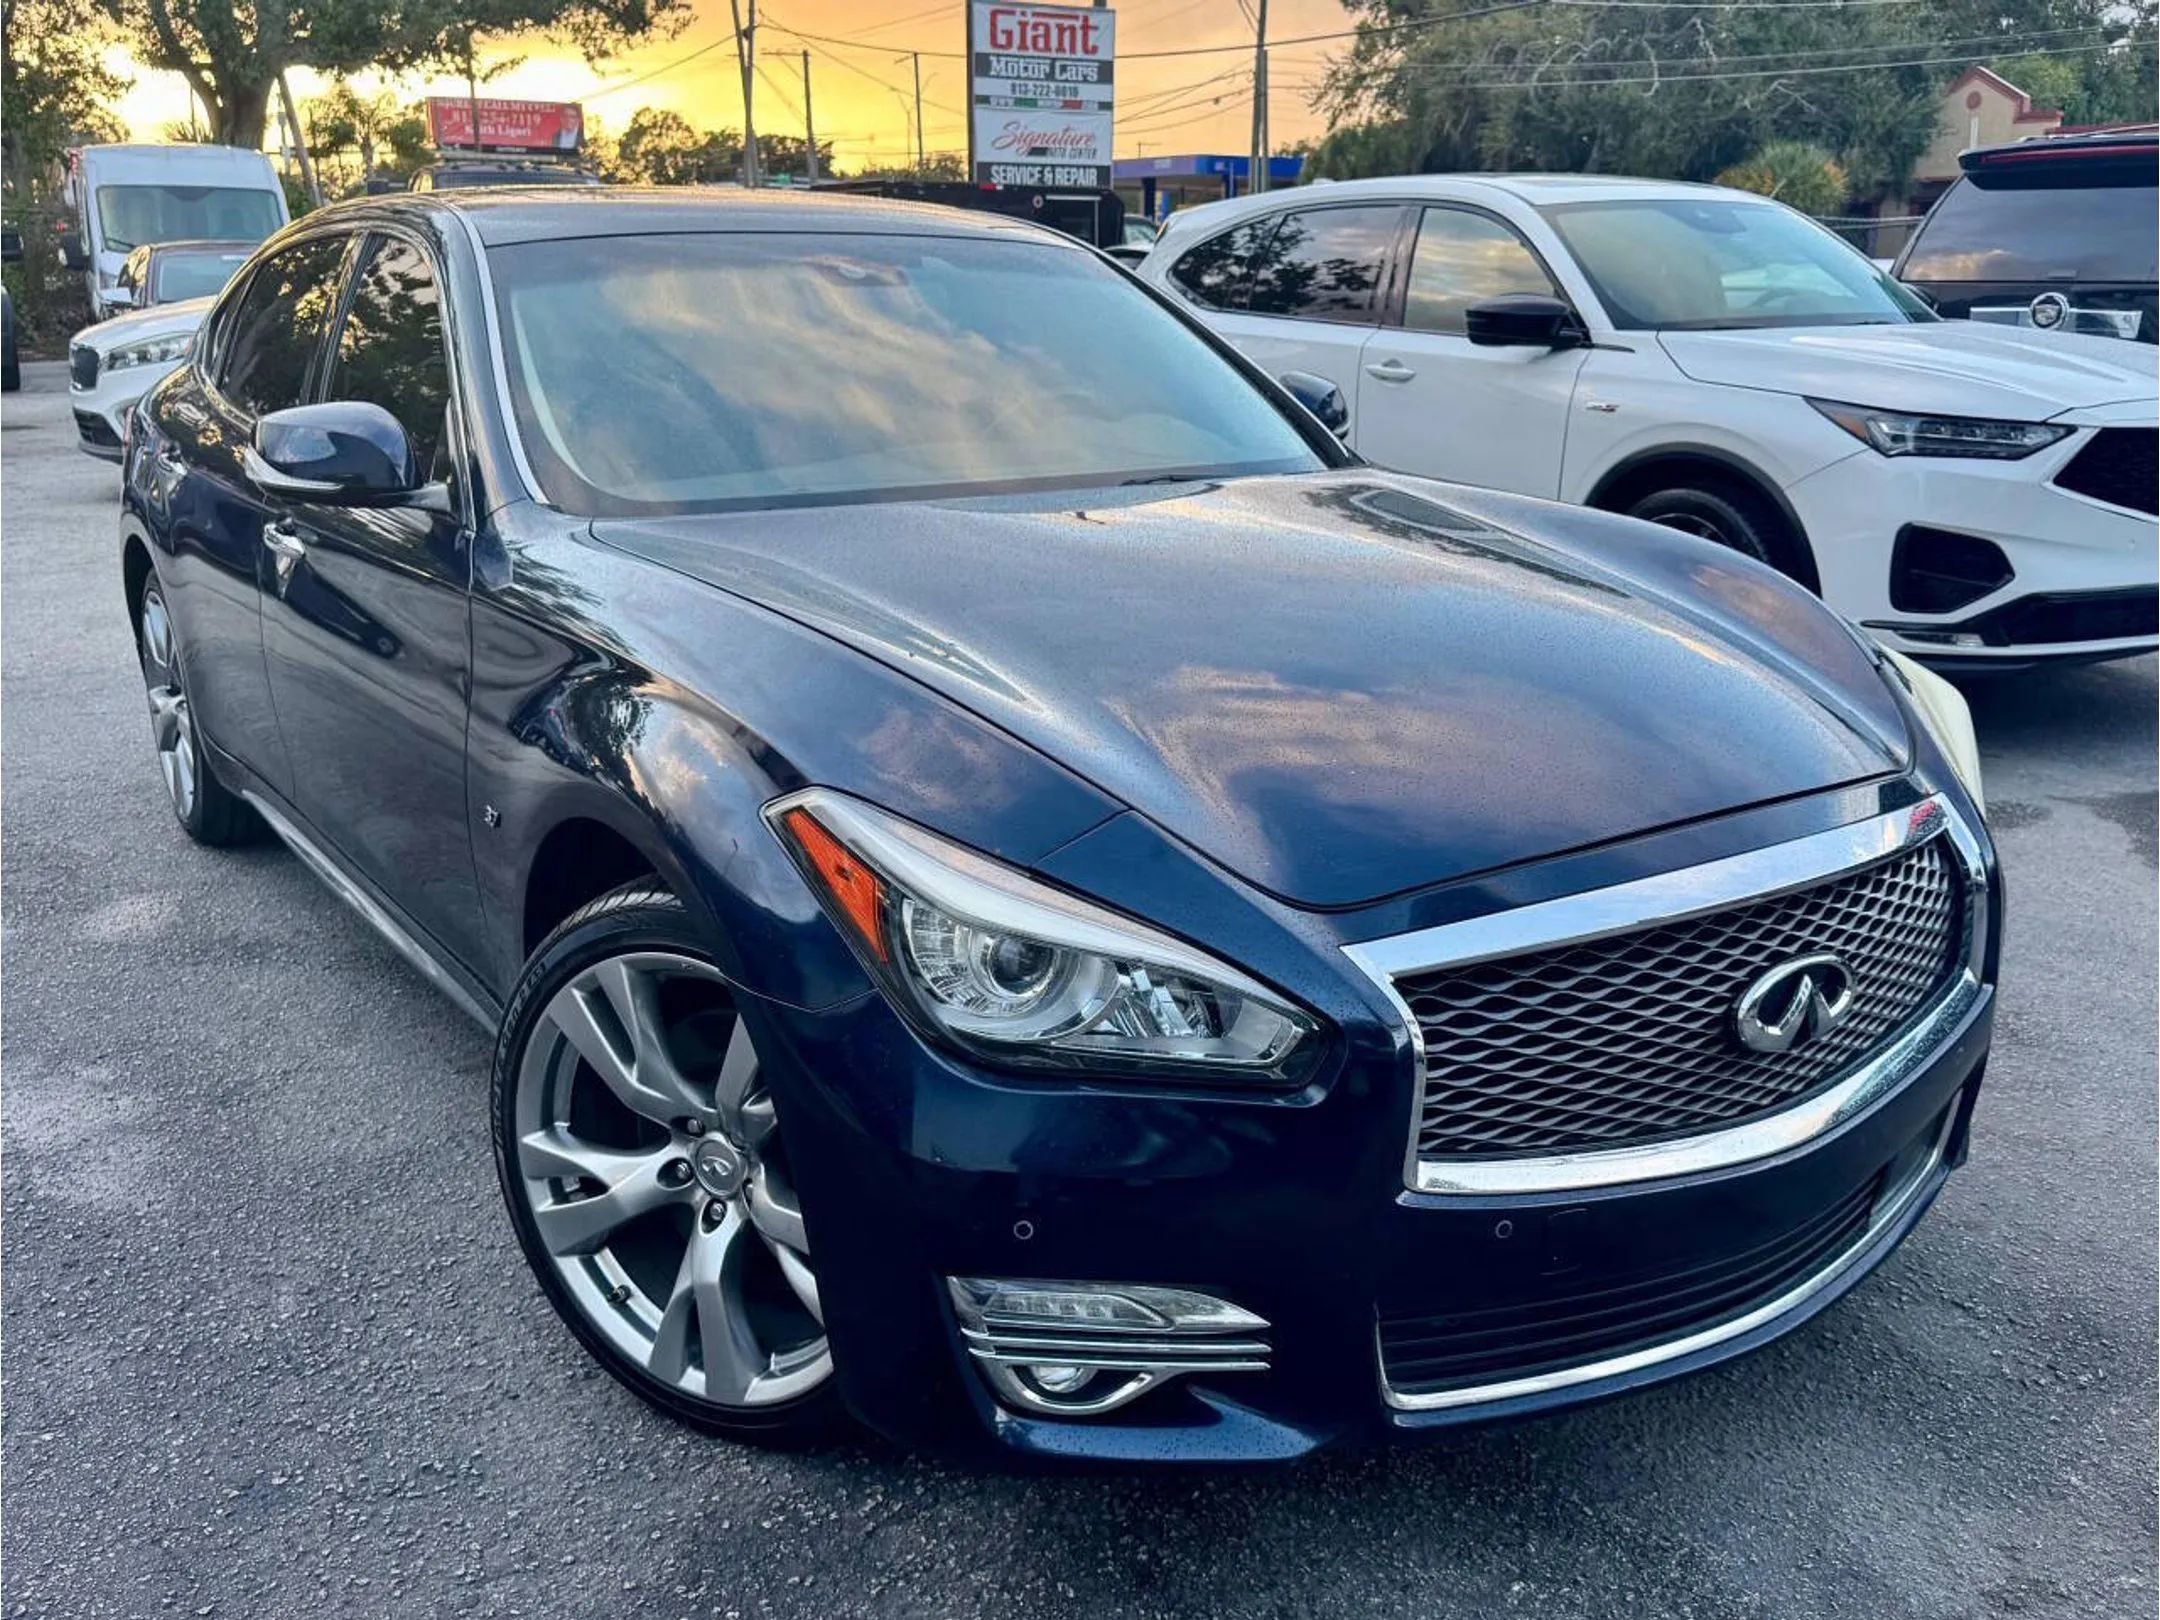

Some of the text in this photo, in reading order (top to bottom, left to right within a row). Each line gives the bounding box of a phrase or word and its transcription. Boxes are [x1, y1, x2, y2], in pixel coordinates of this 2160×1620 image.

[990, 9, 1099, 55] Giant
[989, 56, 1099, 82] Motor Cars
[992, 121, 1096, 156] Signature
[990, 165, 1098, 187] SERVICE & REPAIR
